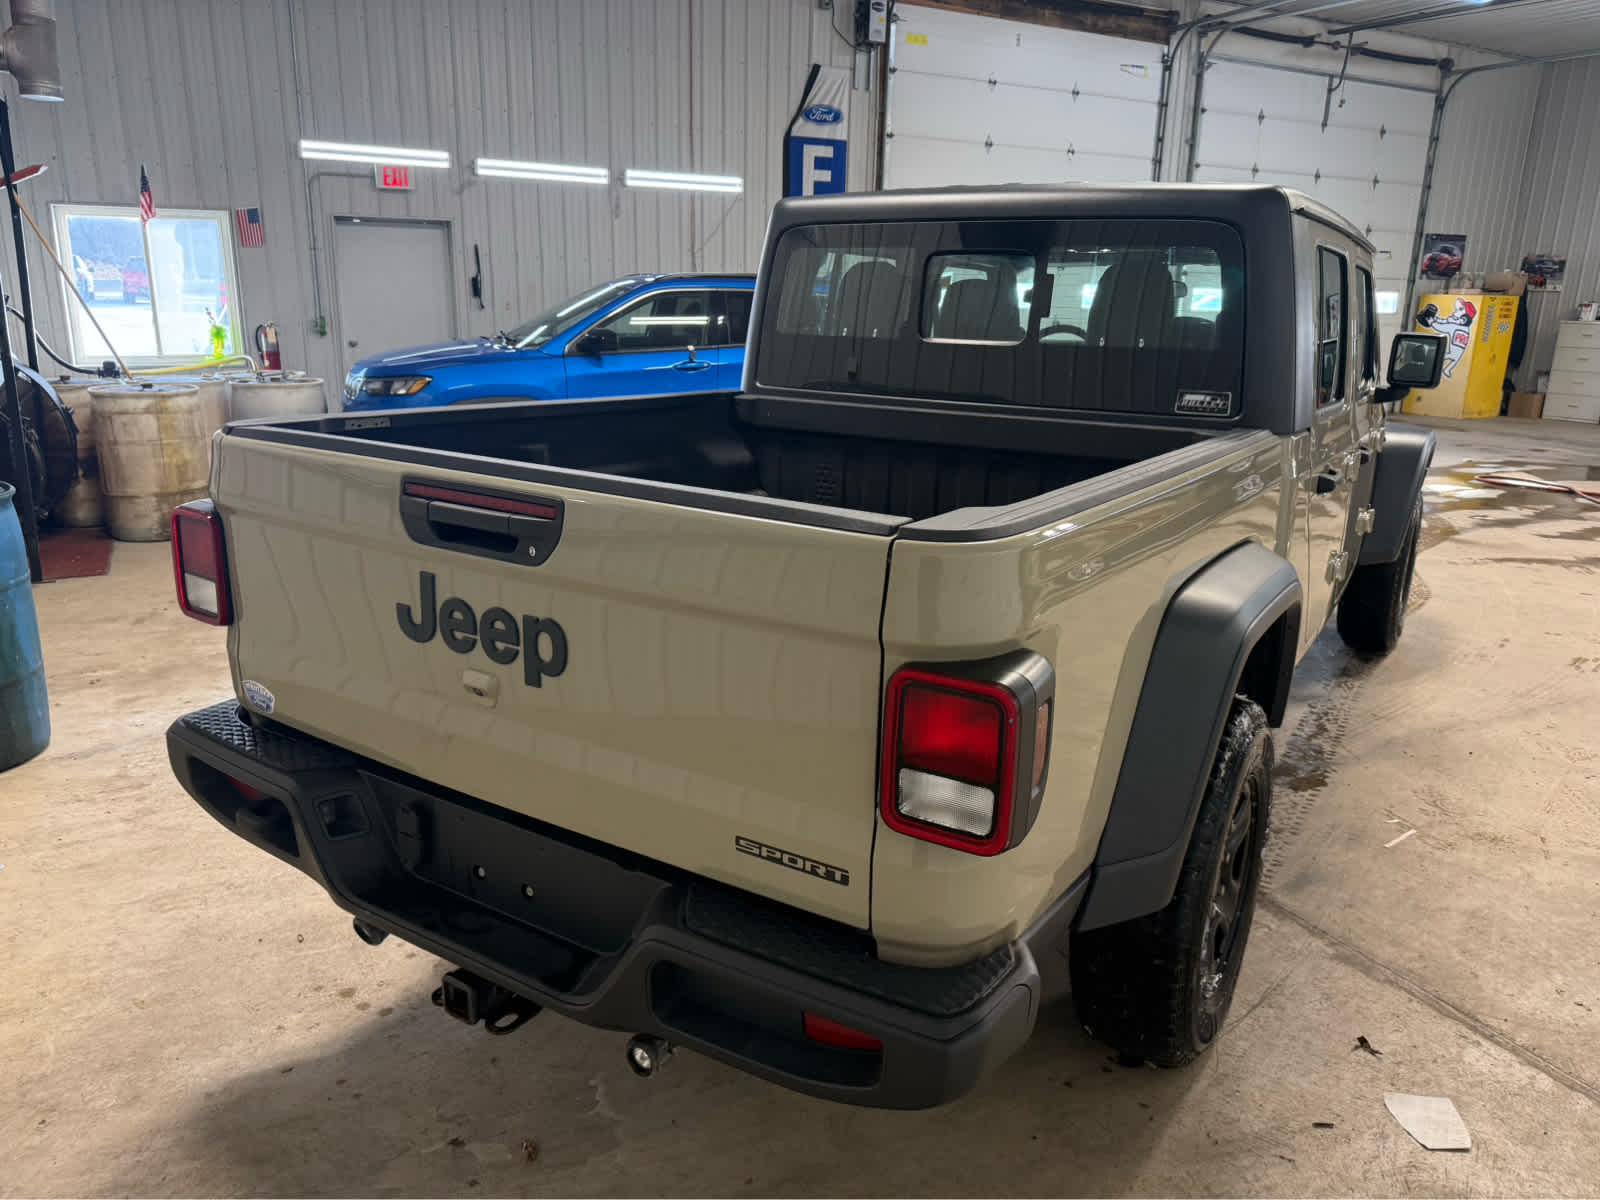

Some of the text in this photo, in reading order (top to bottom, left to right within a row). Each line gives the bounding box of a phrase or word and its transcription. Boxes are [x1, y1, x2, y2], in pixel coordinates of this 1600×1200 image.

[808, 106, 836, 121] Ford
[802, 144, 834, 196] F
[396, 570, 568, 688] Jeep
[735, 836, 849, 885] SPORT
